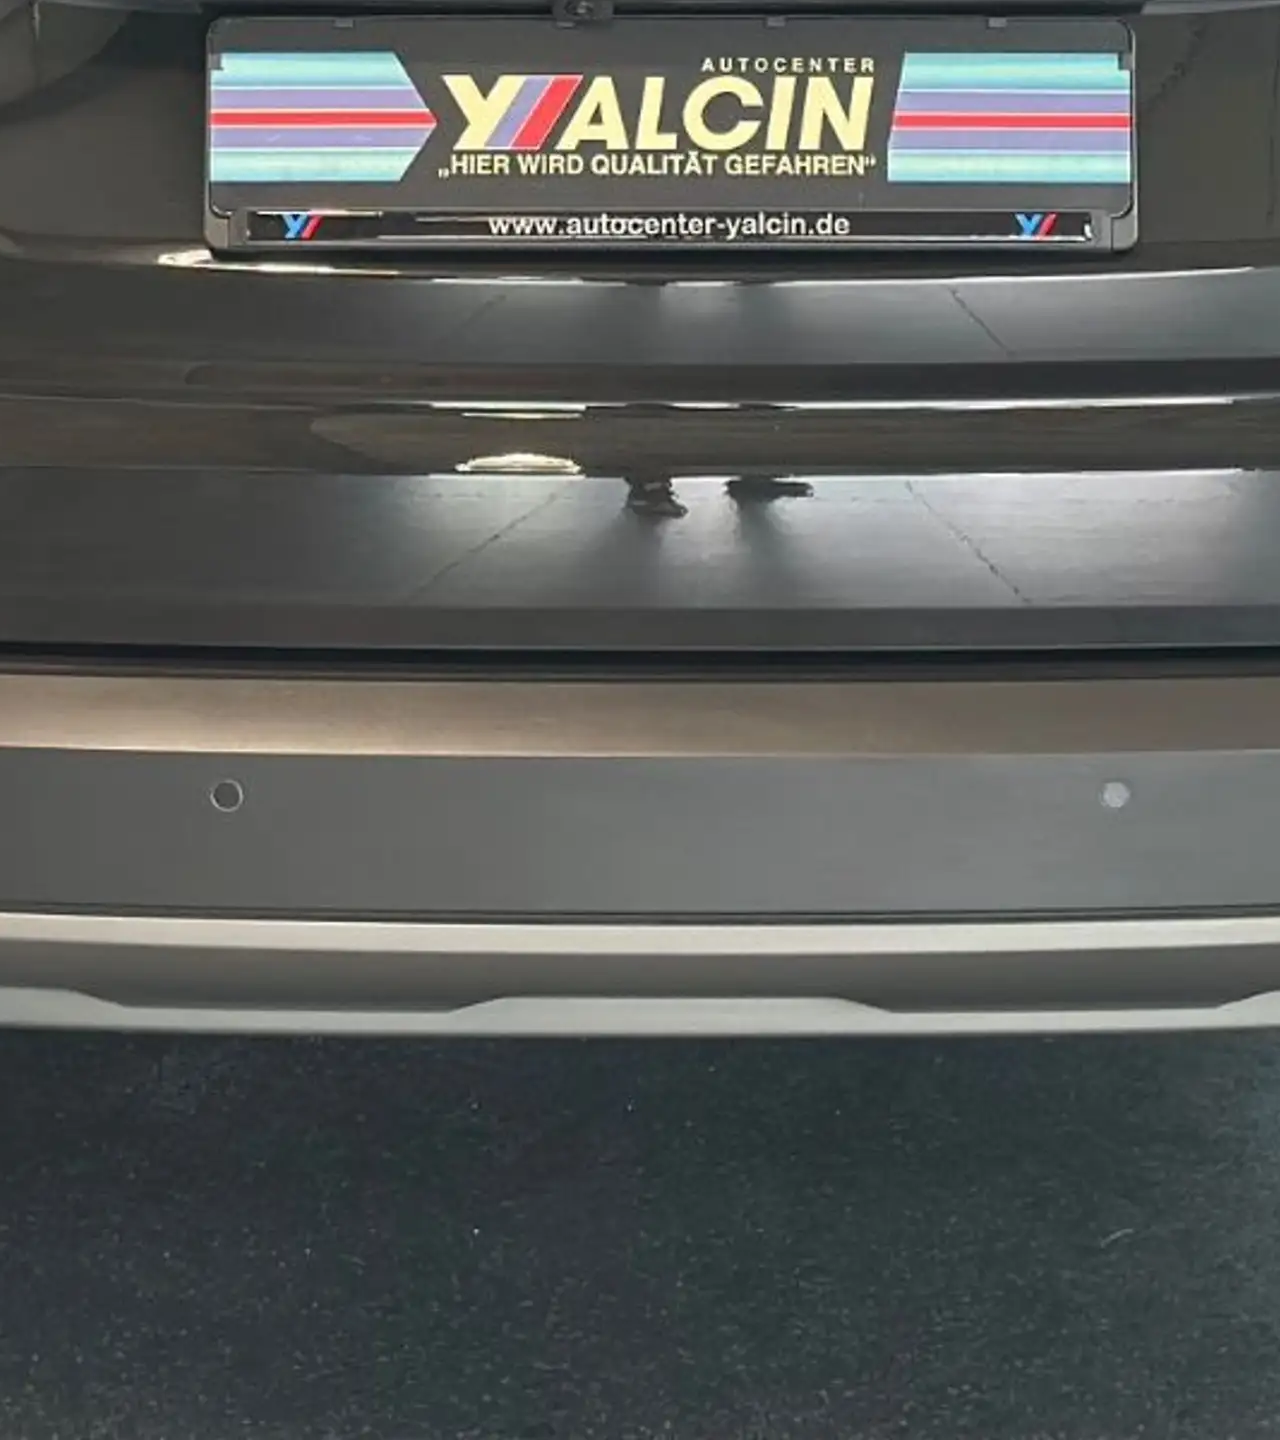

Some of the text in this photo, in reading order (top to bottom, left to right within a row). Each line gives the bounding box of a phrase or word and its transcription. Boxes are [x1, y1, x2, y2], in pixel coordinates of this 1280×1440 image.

[701, 57, 875, 73] AUTOCENTER
[441, 74, 875, 151] YALCIN
[516, 154, 584, 175] WIRD
[591, 151, 718, 176] QUALITÄT
[487, 212, 851, 240] www.autocenter-yalcin.de
